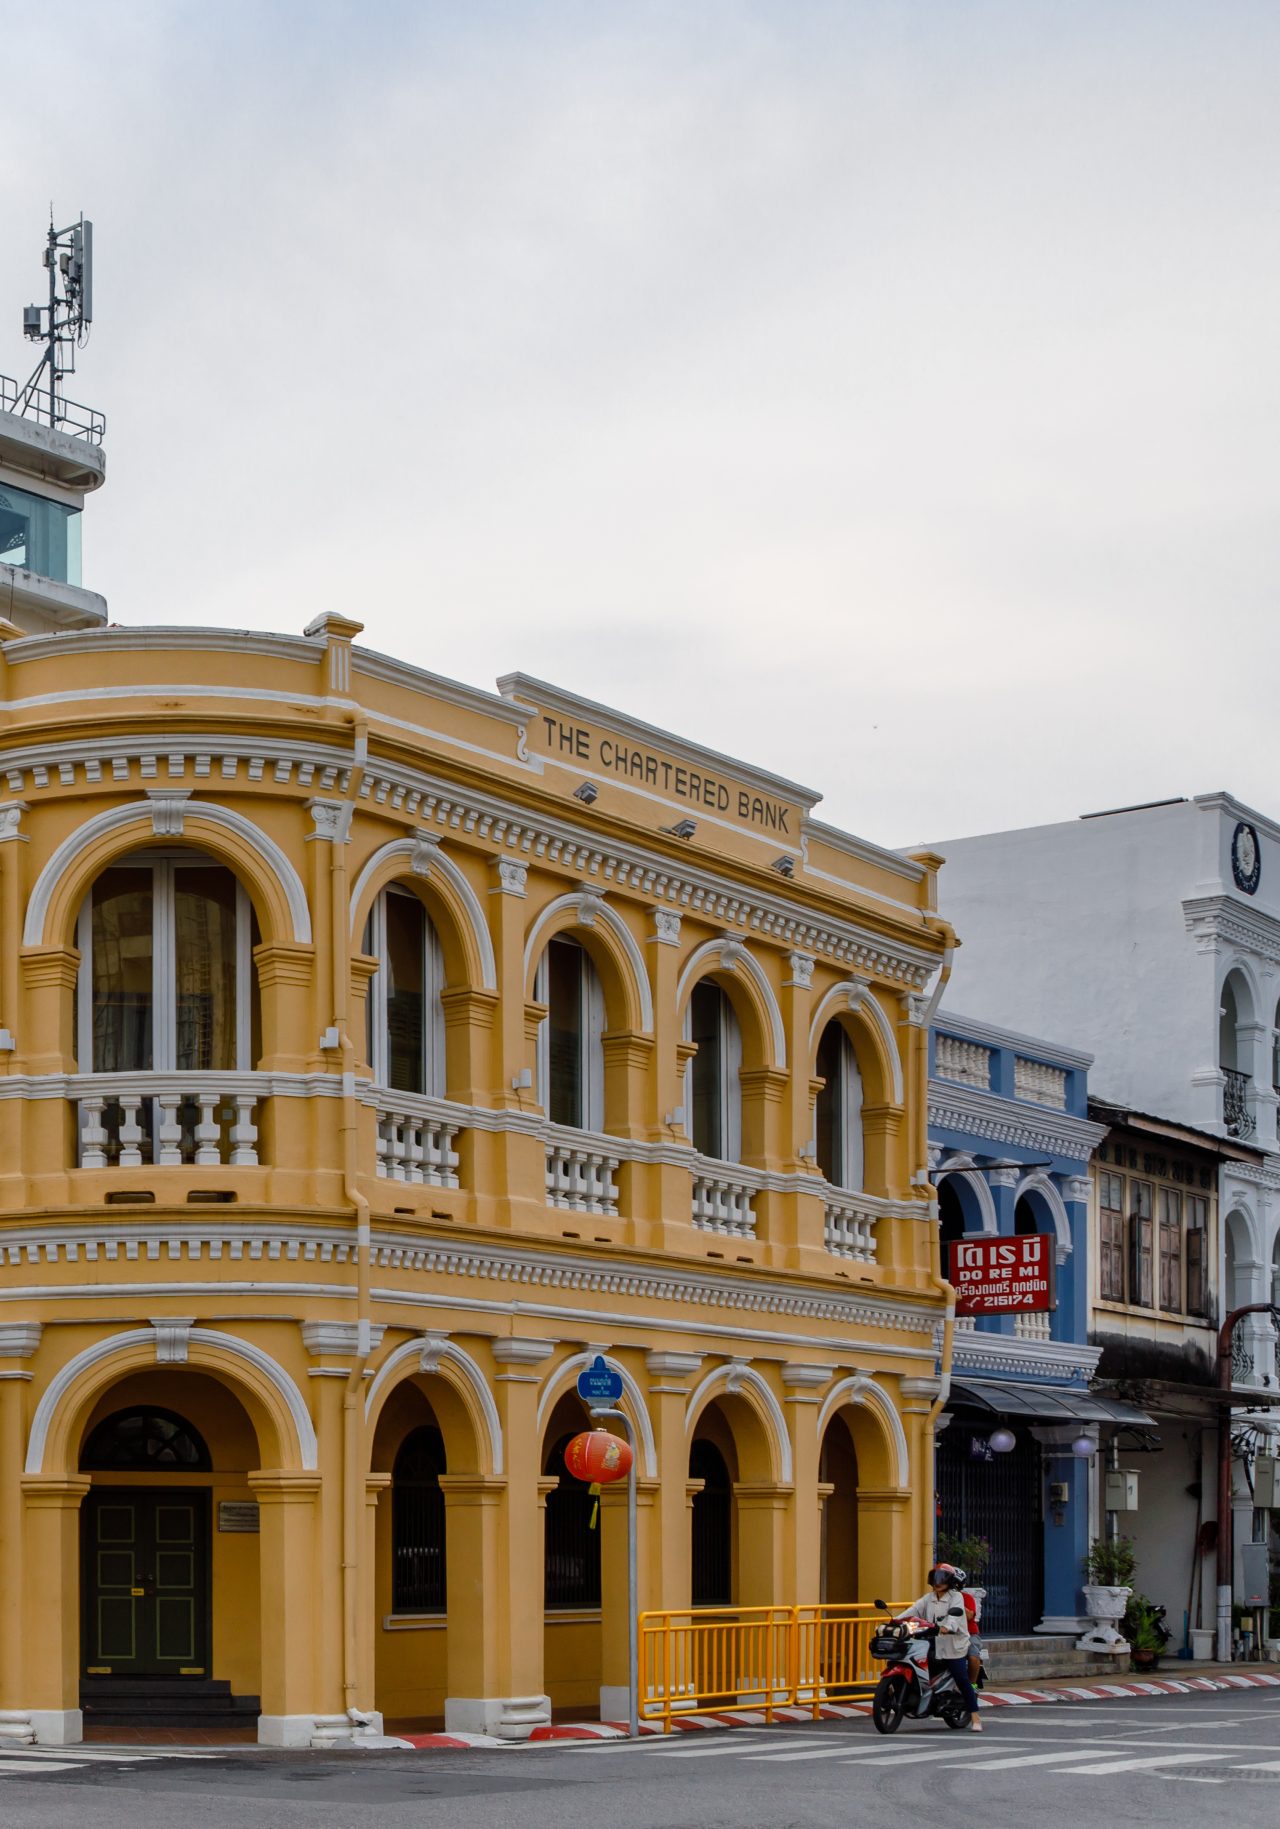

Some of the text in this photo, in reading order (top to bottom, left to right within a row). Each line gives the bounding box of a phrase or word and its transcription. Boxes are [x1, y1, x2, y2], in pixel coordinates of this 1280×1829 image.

[543, 716, 789, 834] THE CHARTERED BANK
[959, 1265, 1039, 1281] DO RE MI
[983, 1294, 1034, 1307] 215174
